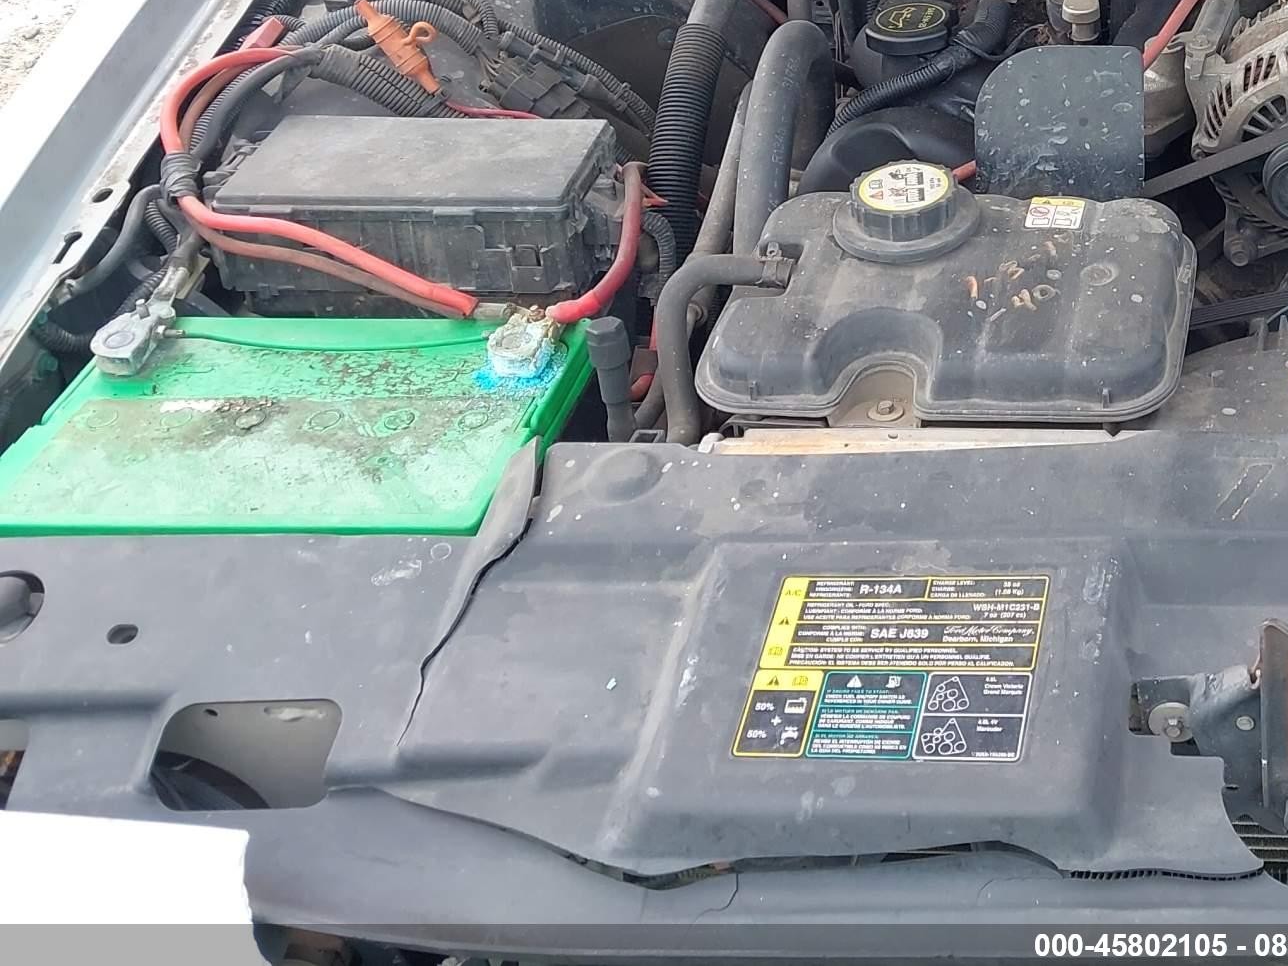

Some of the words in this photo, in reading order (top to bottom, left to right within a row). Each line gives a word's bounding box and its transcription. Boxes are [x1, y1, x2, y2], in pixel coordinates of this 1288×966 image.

[860, 584, 902, 595] R-134A
[870, 628, 897, 639] SAE
[899, 628, 929, 639] J639
[943, 625, 964, 637] Ford
[963, 625, 991, 637] Motor
[980, 635, 1013, 643] Michigan
[755, 702, 775, 711] 50%
[746, 729, 767, 738] 50%
